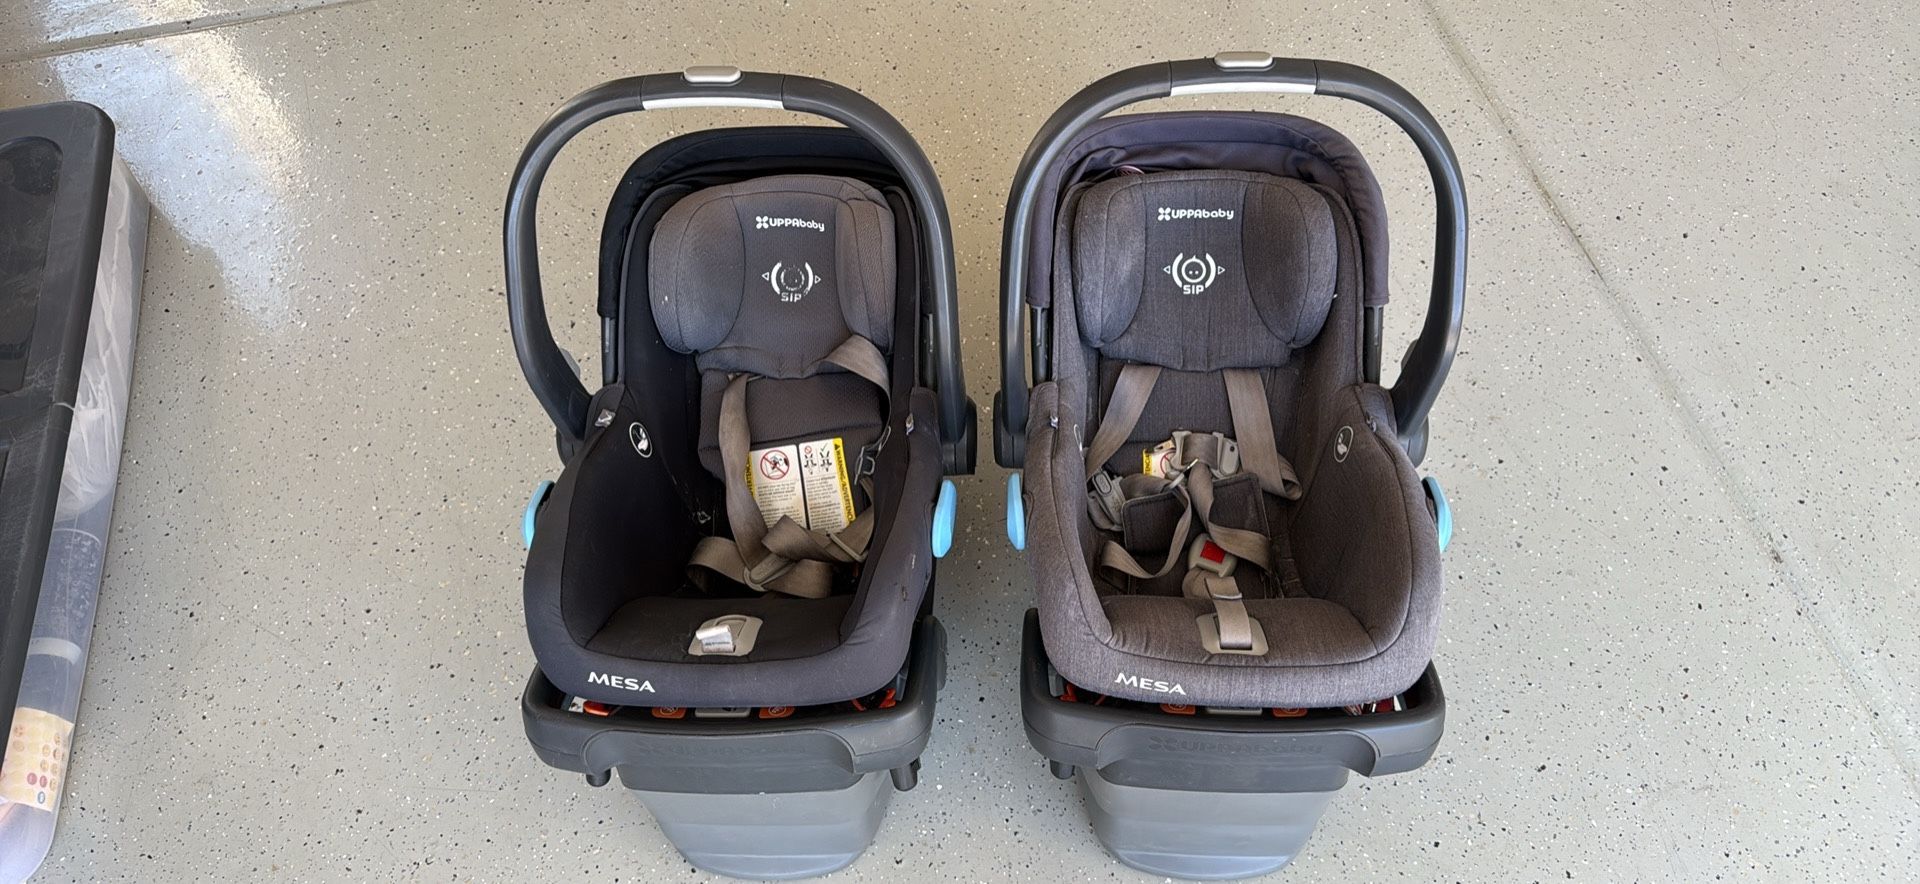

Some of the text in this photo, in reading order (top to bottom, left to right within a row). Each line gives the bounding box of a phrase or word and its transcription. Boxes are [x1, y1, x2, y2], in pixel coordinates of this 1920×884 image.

[1171, 208, 1234, 220] UPPAbaby
[769, 217, 825, 232] UPPAbaby
[1183, 284, 1204, 295] SIP
[781, 292, 802, 303] SIP
[588, 671, 656, 693] MESA
[1114, 673, 1187, 696] MESA
